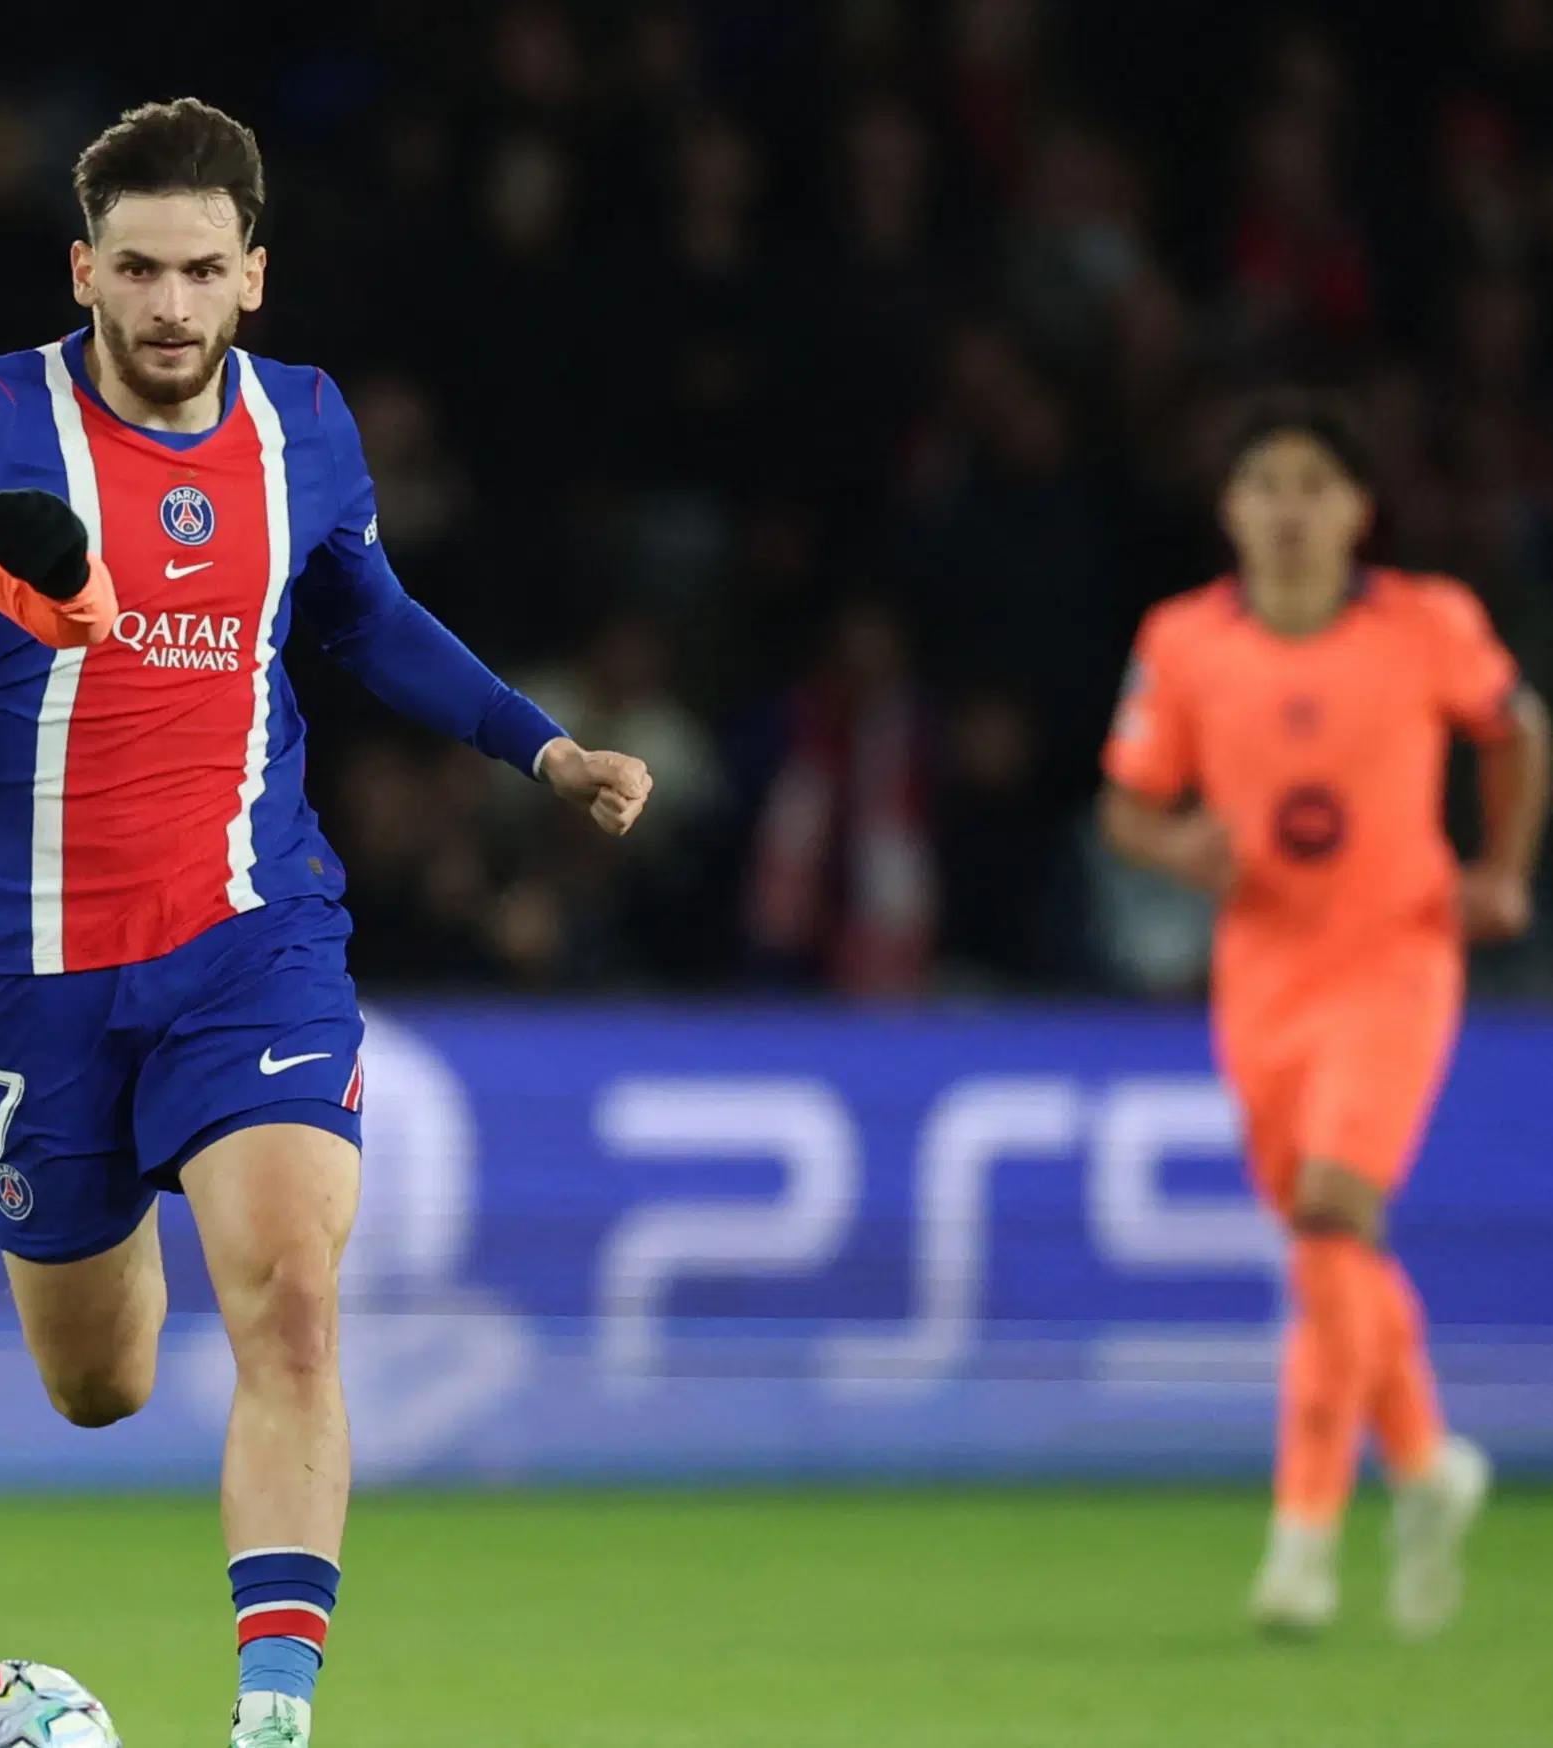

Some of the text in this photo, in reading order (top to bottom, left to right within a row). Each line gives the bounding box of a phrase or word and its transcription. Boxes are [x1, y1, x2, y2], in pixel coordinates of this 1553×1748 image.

[168, 489, 204, 506] PARIS
[111, 610, 241, 652] QATAR
[141, 645, 240, 672] AIRWAYS
[595, 1078, 1289, 1402] PS5
